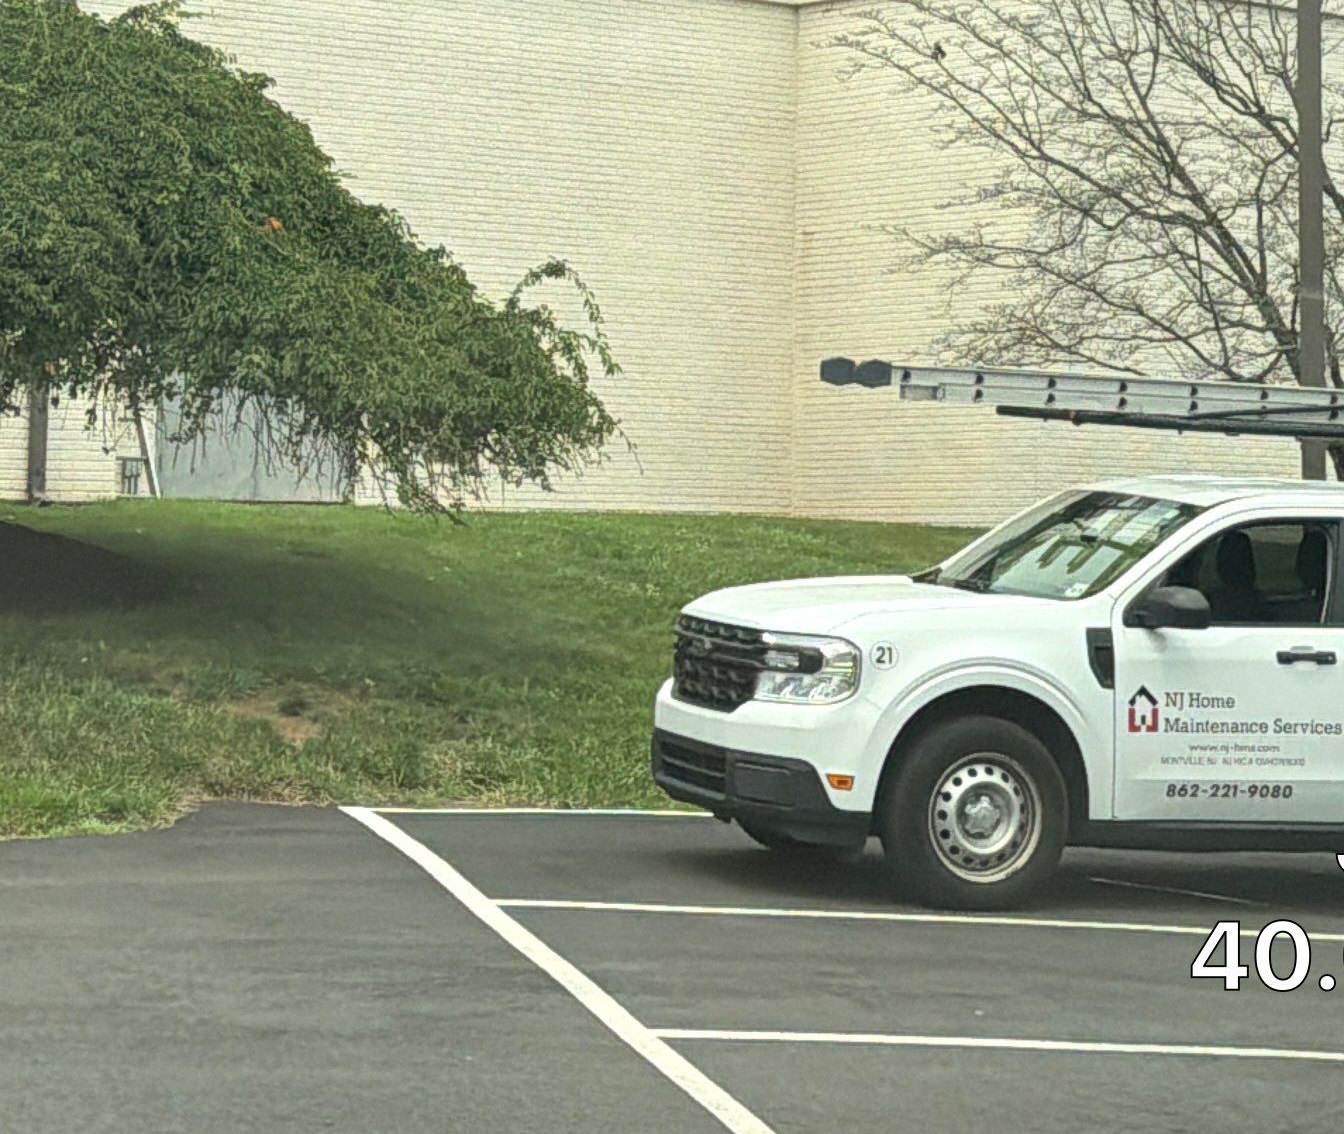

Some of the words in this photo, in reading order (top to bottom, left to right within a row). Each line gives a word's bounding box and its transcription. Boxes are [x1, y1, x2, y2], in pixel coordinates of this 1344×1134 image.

[876, 646, 893, 665] 21
[1164, 692, 1184, 711] NJ
[1188, 692, 1236, 709] Home
[1163, 717, 1269, 734] Maintenance
[1272, 718, 1343, 735] Services
[1165, 783, 1294, 799] 862-221-9080
